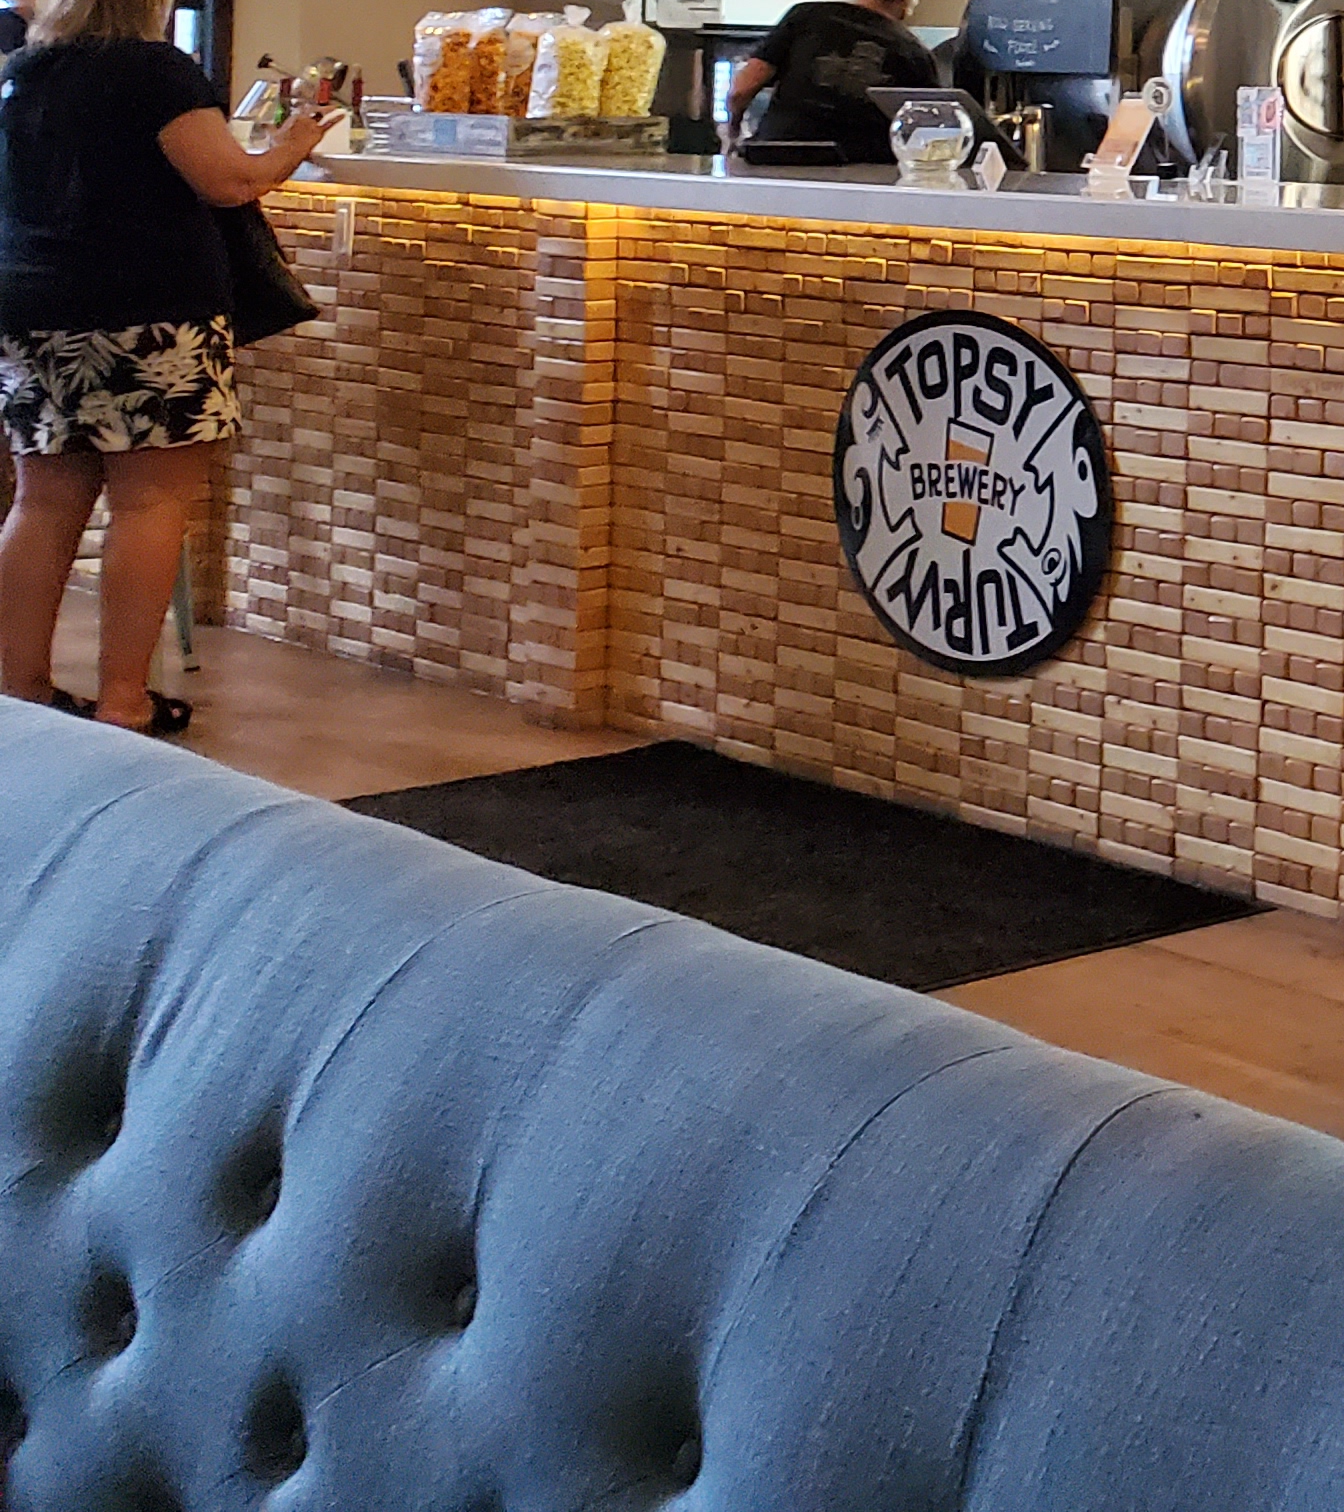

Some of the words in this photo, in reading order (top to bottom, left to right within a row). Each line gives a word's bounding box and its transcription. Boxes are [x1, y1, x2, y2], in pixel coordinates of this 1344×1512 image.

[885, 332, 1054, 442] TOPSY
[909, 463, 1027, 516] BREWERY
[887, 547, 1040, 655] TURVY
